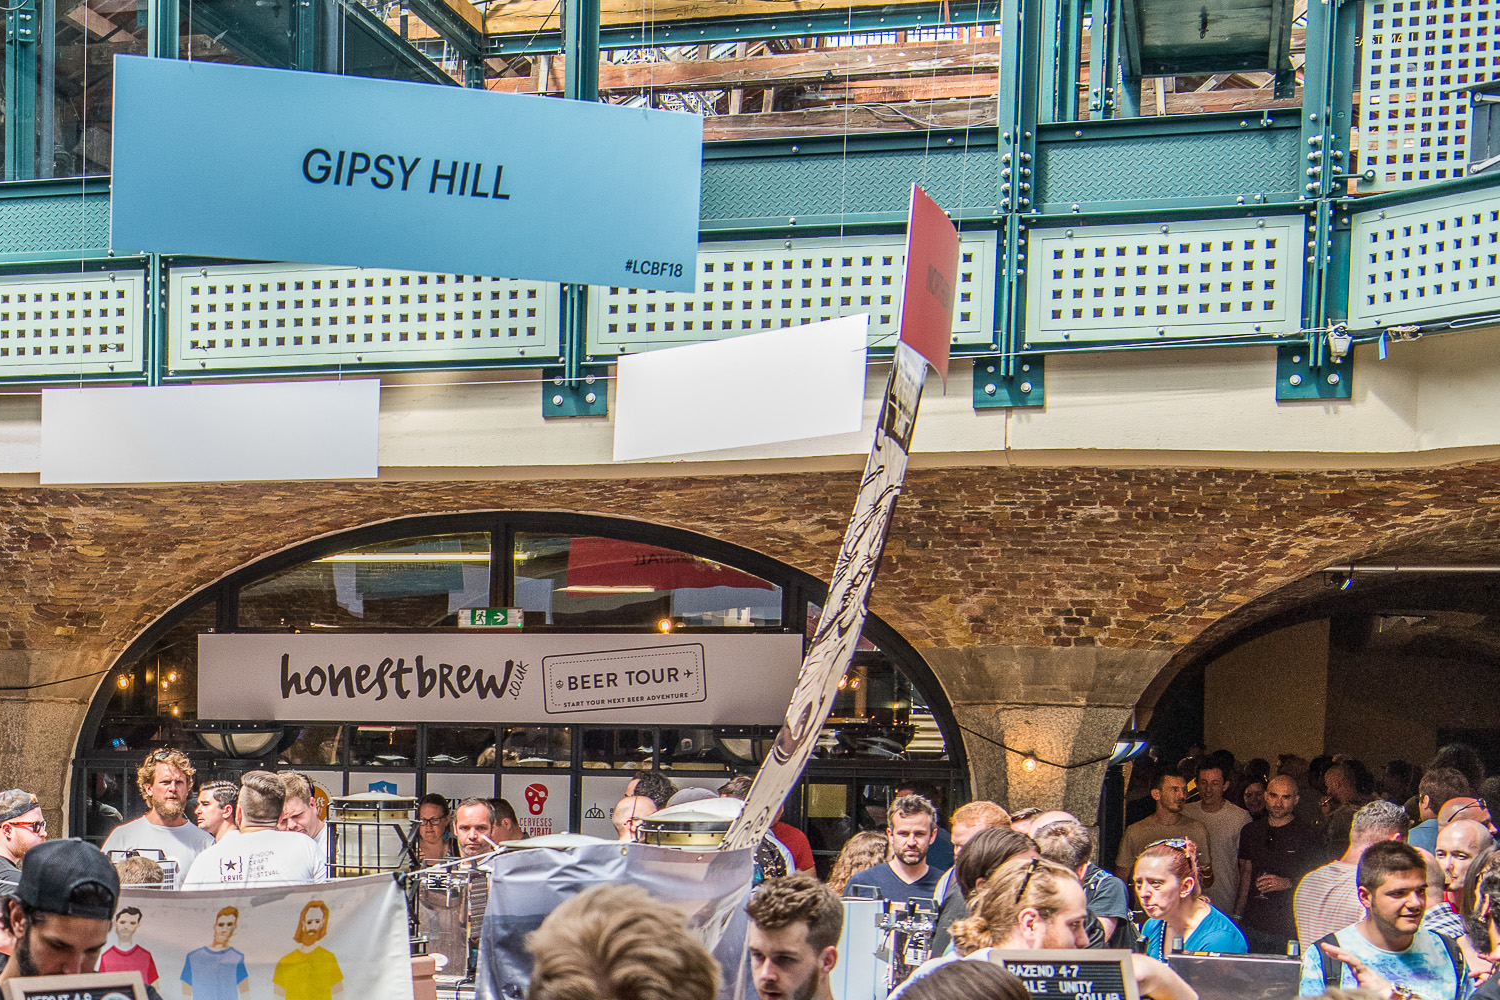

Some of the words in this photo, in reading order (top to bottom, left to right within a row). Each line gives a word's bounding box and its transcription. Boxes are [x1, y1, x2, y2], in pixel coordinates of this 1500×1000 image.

[302, 147, 422, 192] GIPSY
[428, 159, 511, 200] HILL
[625, 259, 684, 278] #LCBF18
[567, 672, 618, 691] BEER
[625, 667, 679, 686] TOUR
[646, 692, 688, 702] ADVENTURE
[519, 817, 552, 827] CERVESES
[1058, 980, 1094, 993] UNITY
